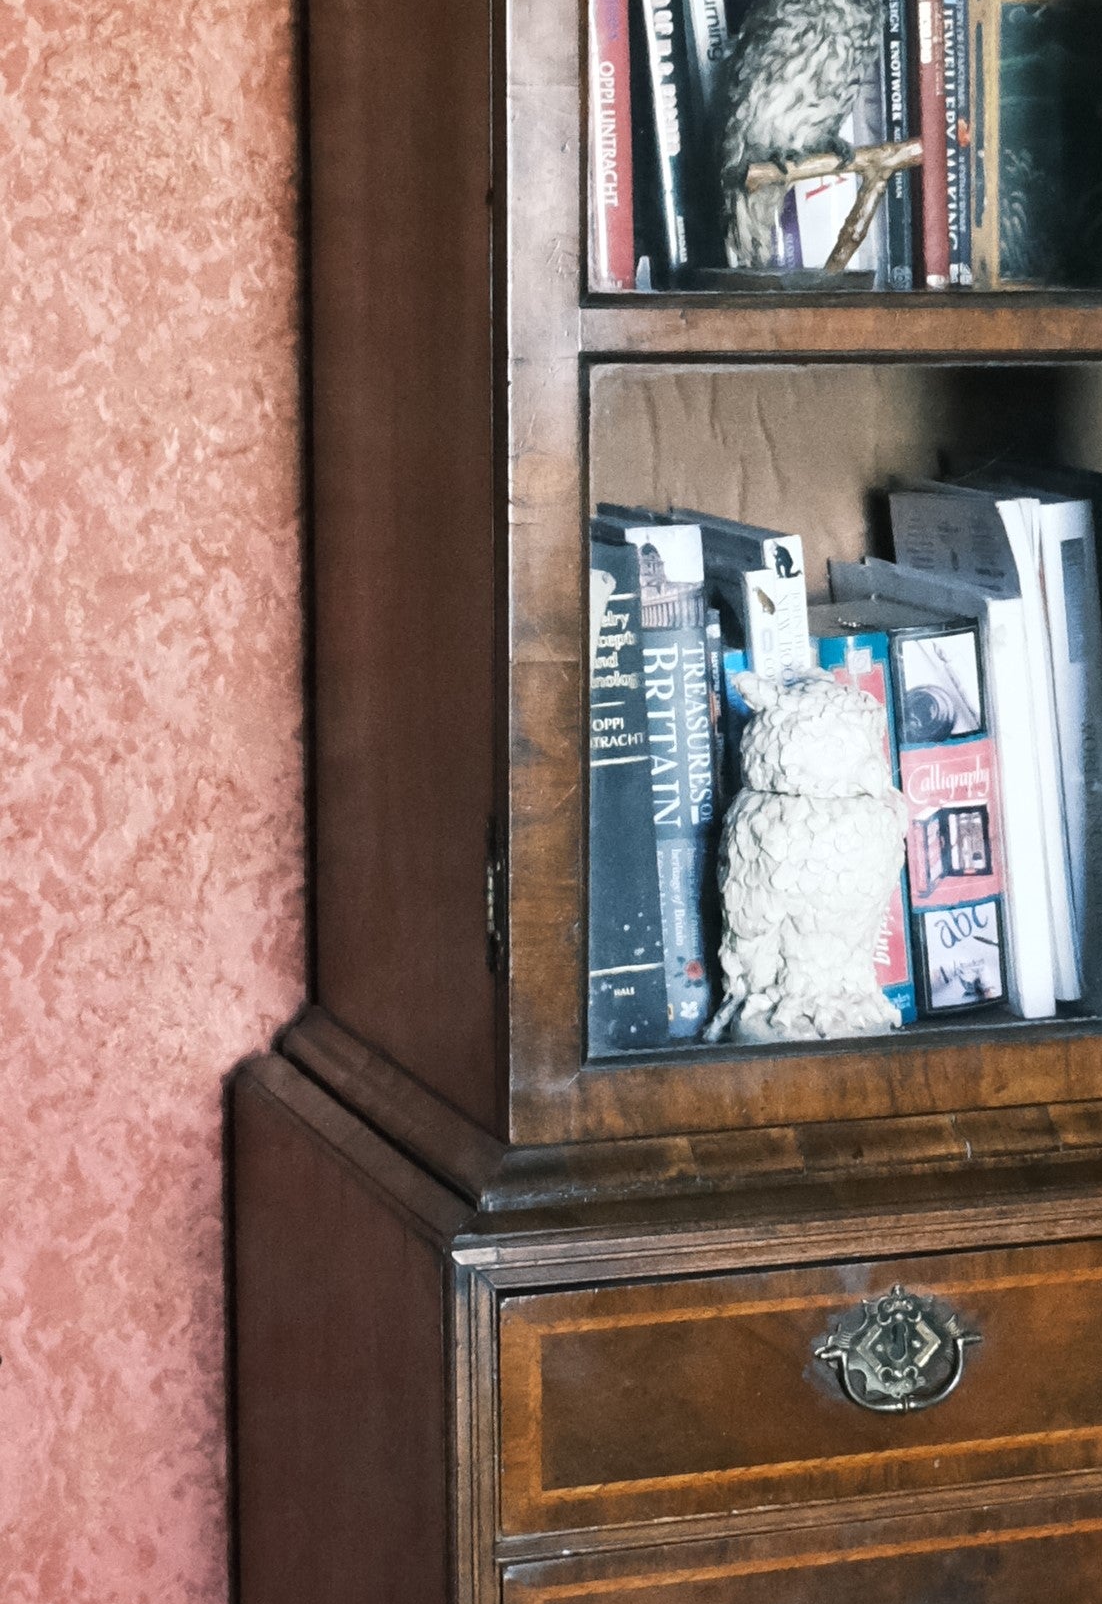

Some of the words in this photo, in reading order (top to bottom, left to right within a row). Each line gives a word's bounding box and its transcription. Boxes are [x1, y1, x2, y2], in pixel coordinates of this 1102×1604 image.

[599, 61, 615, 103] OPPI
[889, 40, 902, 120] KNOTWORK
[944, 9, 958, 141] JEWELLERY
[601, 108, 618, 207] UNTRACHT
[946, 148, 959, 251] MAKING
[601, 610, 630, 629] elry
[590, 732, 644, 749] TRACHT
[592, 717, 624, 732] OPPI
[643, 642, 682, 829] BRITAIN
[682, 641, 712, 803] TREASURES
[907, 754, 990, 804] Calligraphy
[671, 848, 682, 893] heritage
[674, 908, 686, 946] Britain
